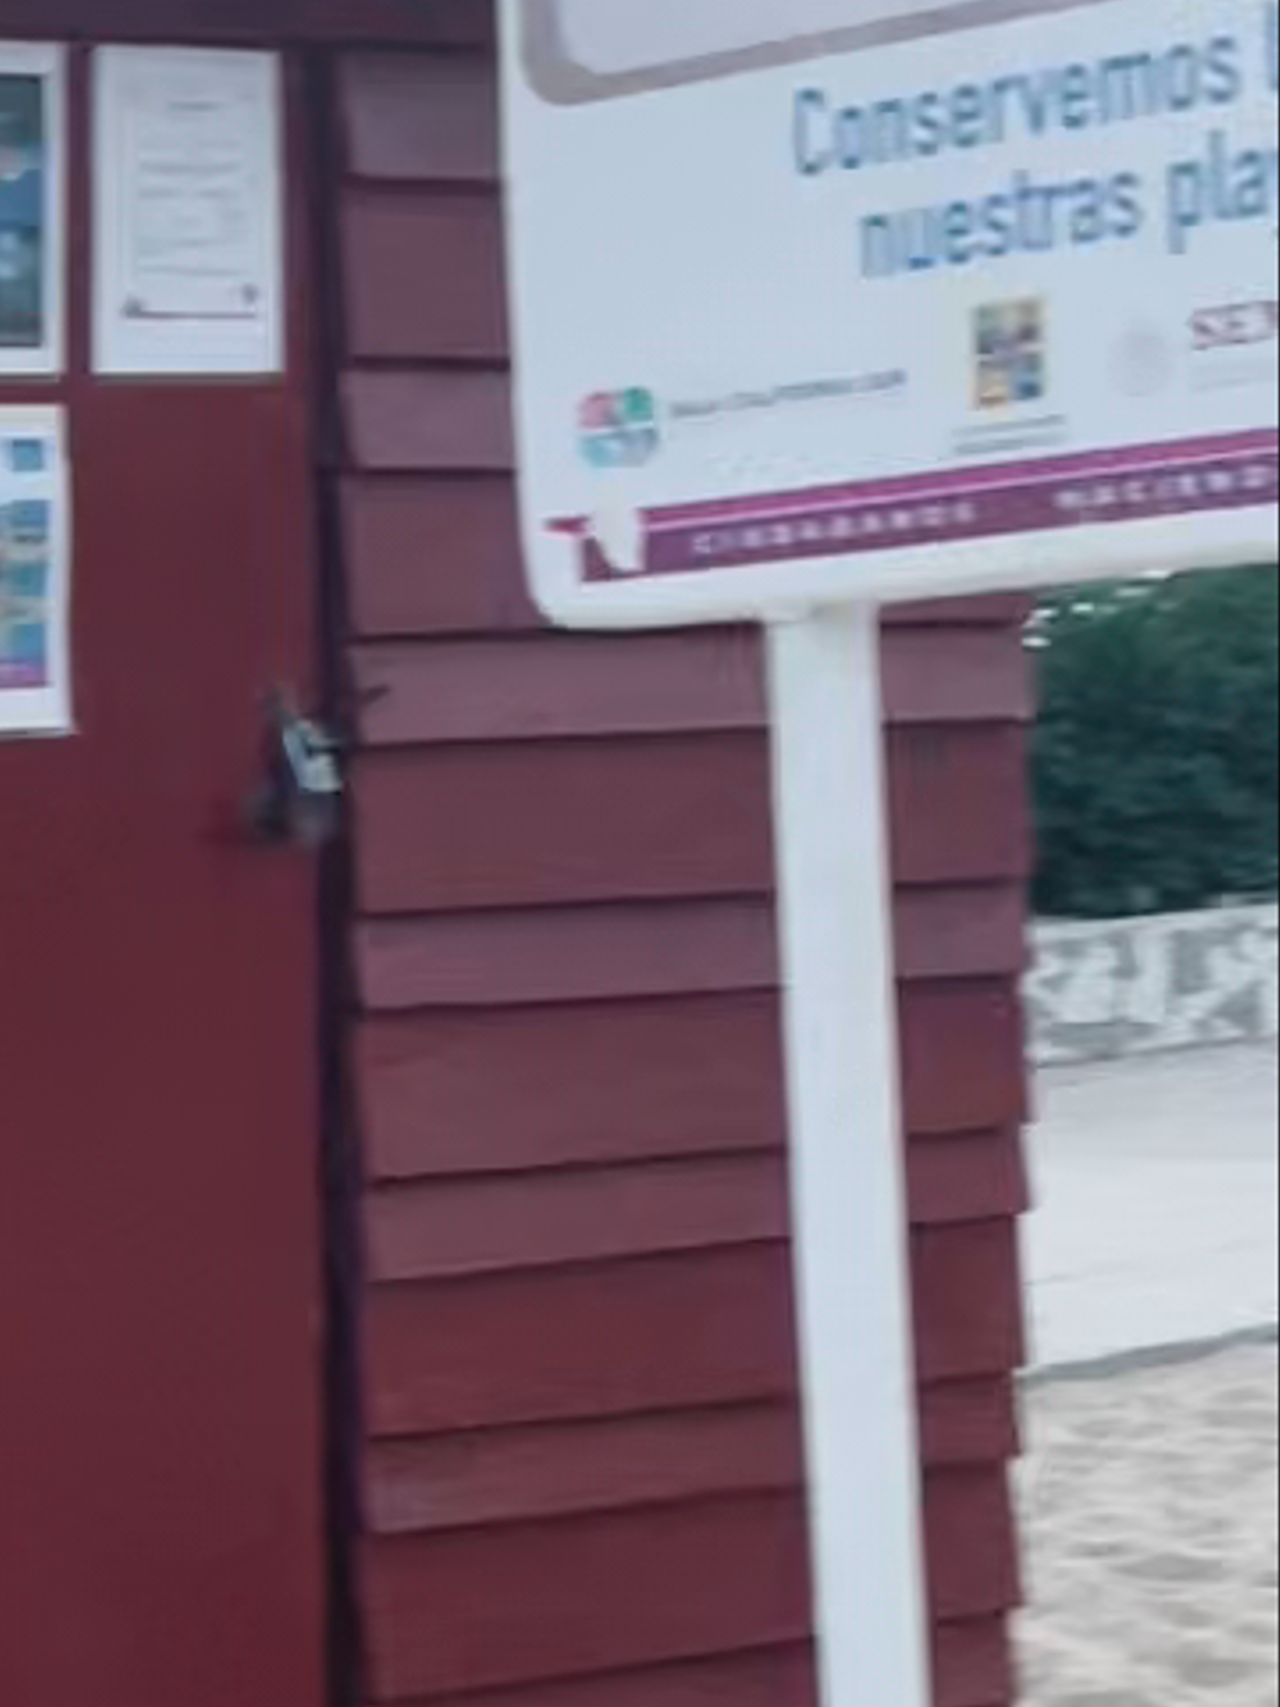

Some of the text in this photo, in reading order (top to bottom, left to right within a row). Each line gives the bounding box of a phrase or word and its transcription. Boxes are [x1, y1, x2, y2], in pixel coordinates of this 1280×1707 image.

[793, 34, 1238, 177] Conservemos
[858, 129, 1278, 279] nuestras pla
